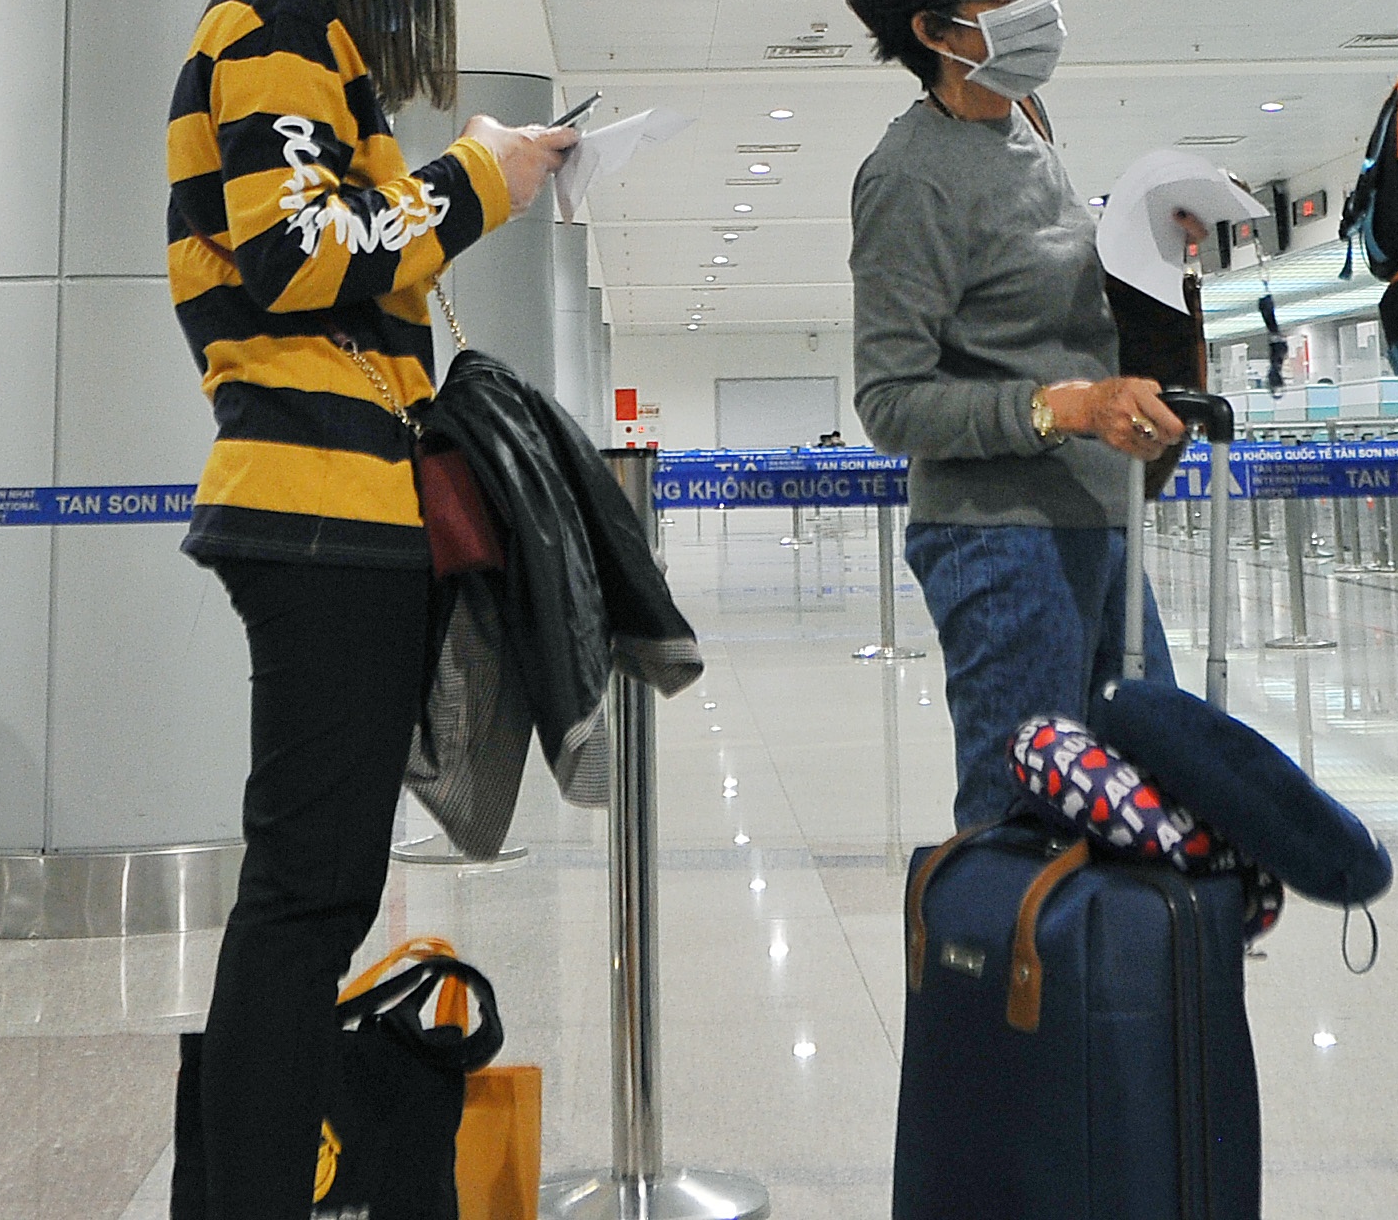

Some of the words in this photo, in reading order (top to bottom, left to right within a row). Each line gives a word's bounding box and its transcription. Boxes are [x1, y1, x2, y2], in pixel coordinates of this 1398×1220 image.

[1243, 449, 1283, 462] KHÔNG
[815, 460, 838, 471] TAN
[840, 460, 865, 471] SON
[867, 459, 897, 470] NHAT
[1346, 468, 1390, 488] TAN
[9, 489, 35, 499] NHAT
[689, 476, 774, 500] KHÔNG
[782, 474, 850, 500] QUỐC
[56, 495, 101, 515] TAN
[107, 494, 156, 514] SON
